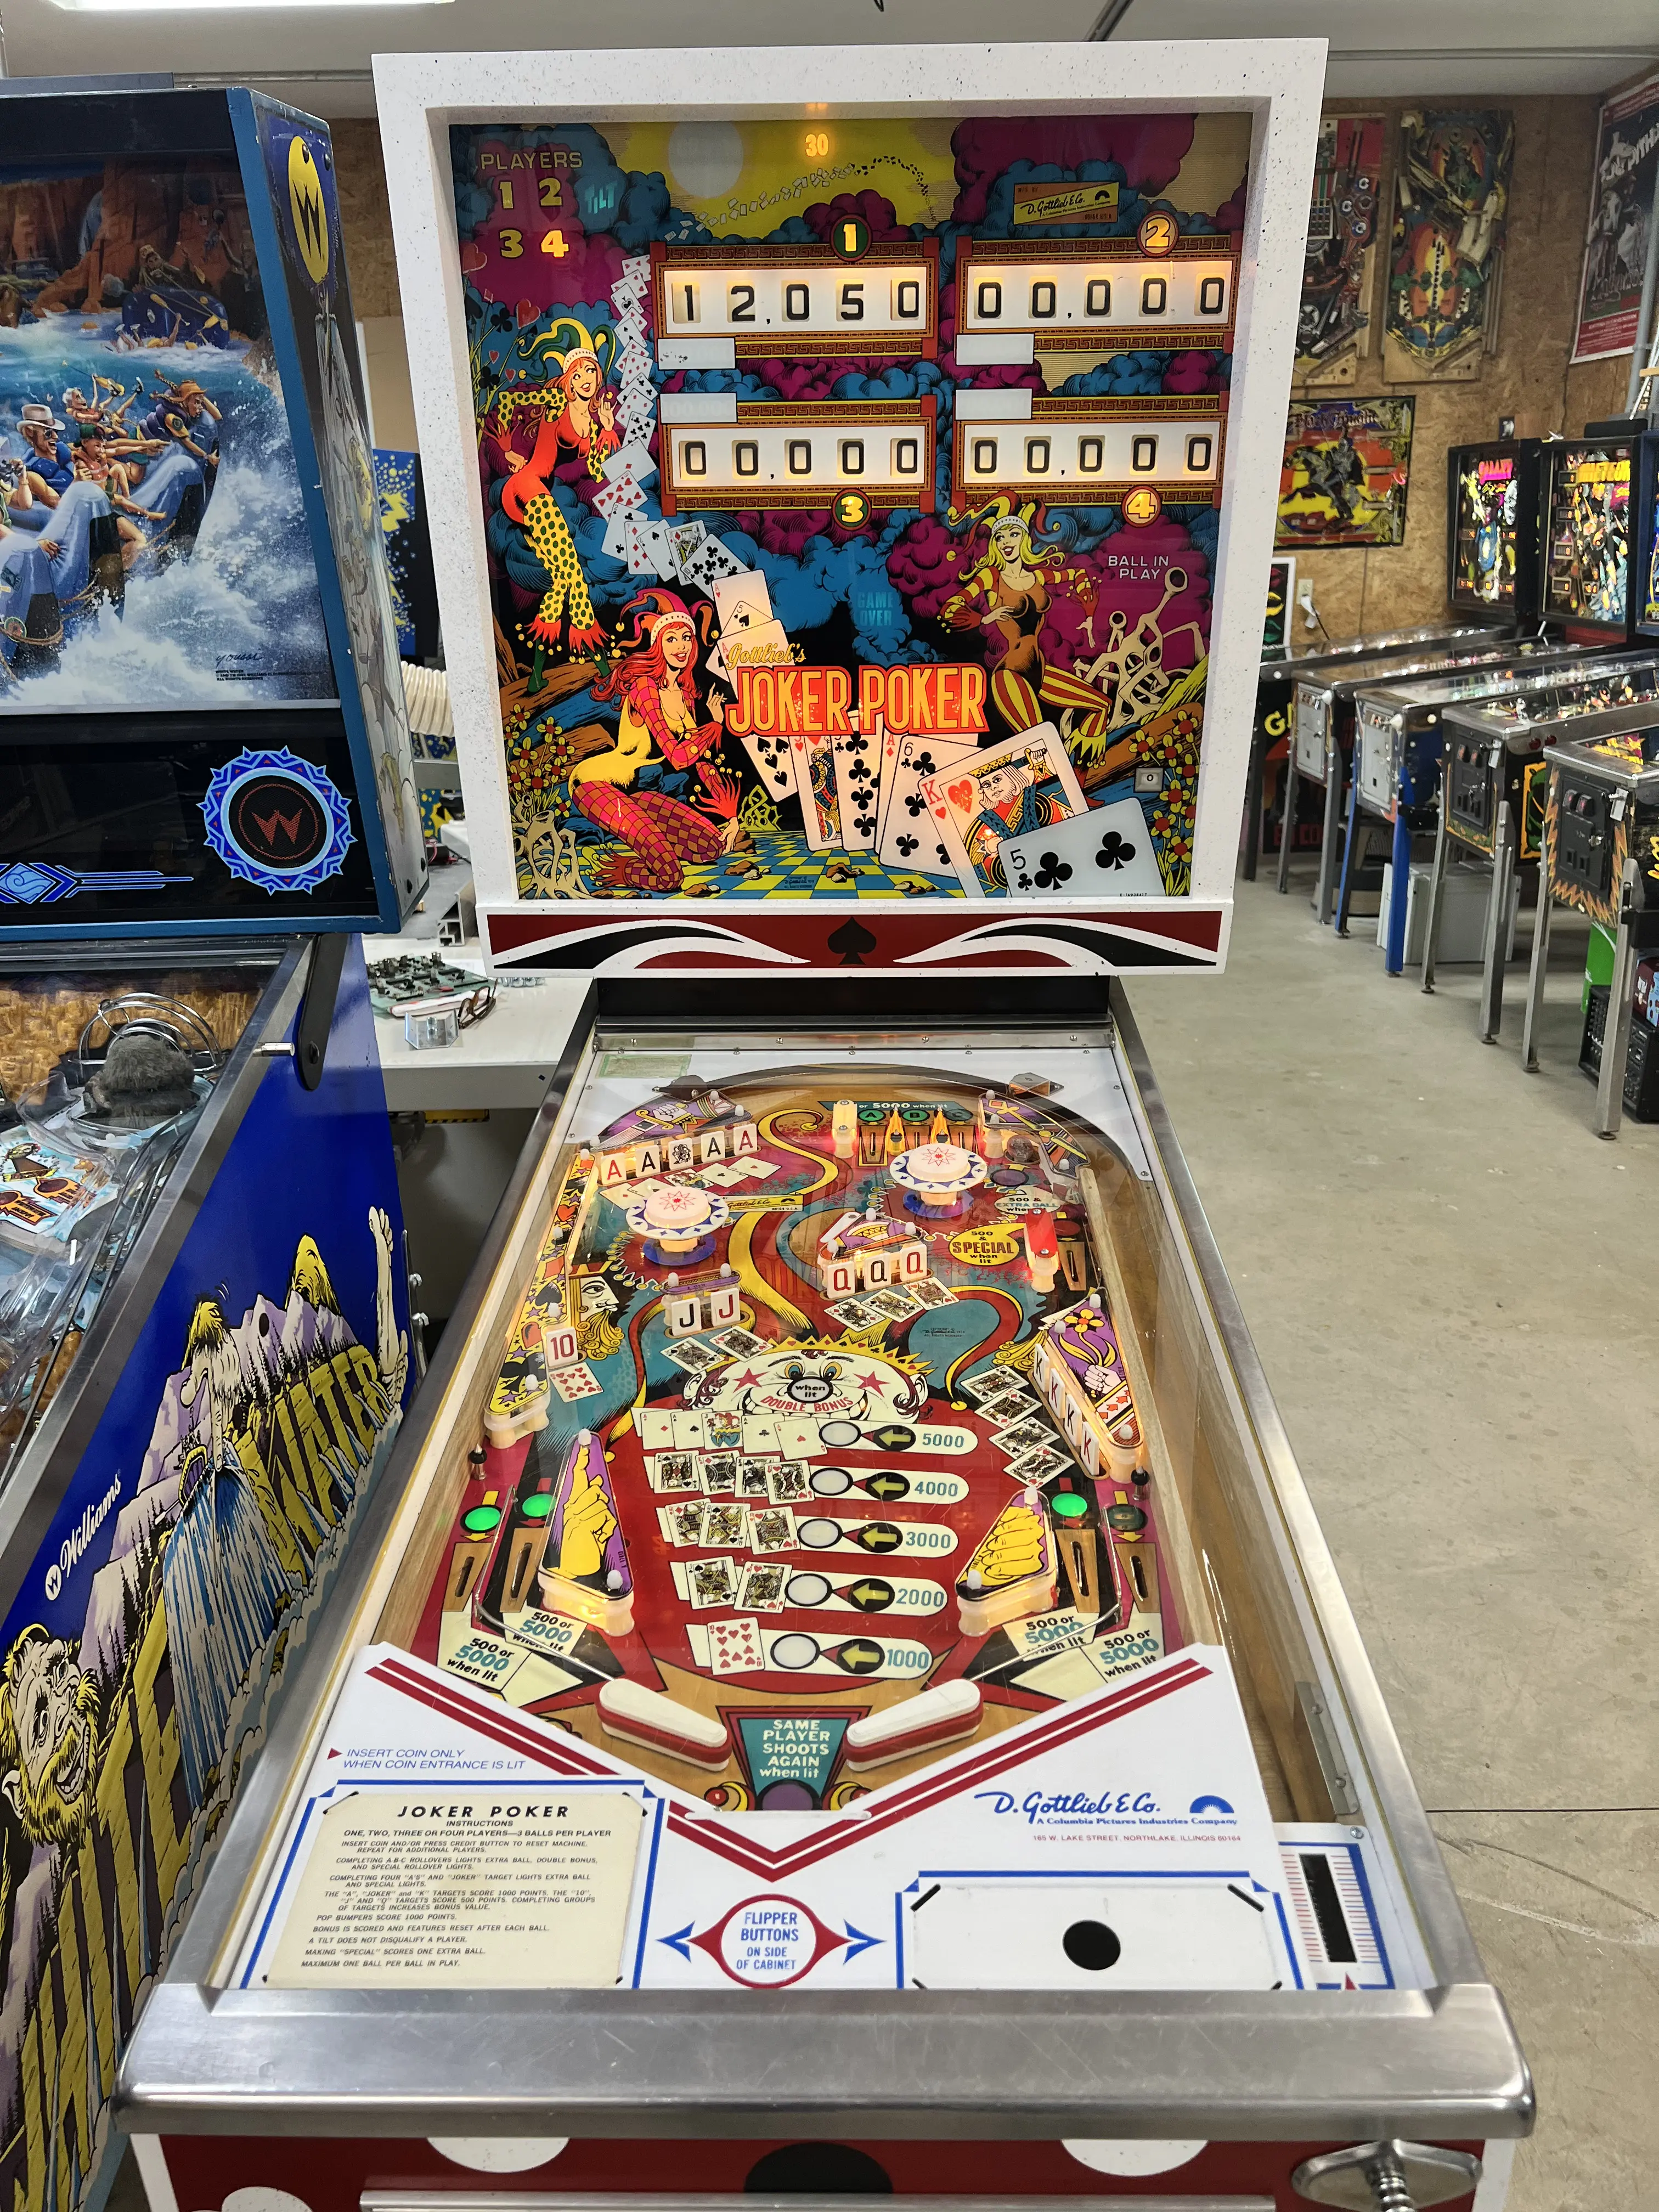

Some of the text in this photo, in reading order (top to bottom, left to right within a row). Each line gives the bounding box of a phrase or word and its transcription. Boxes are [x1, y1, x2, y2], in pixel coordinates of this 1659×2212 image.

[805, 133, 829, 157] 30
[481, 151, 583, 170] PLAYERS
[499, 177, 562, 210] 1 2
[1020, 203, 1036, 215] D.
[1037, 195, 1068, 217] Gottlieb
[499, 229, 569, 258] 3 4
[843, 223, 857, 252] 1
[1144, 218, 1174, 249] 2
[840, 496, 865, 522] 3
[1127, 492, 1155, 518] 4
[1108, 555, 1169, 567] BALL IN
[1119, 568, 1161, 580] PLAY
[857, 591, 893, 608] GAME
[860, 610, 892, 626] OVER
[725, 643, 806, 670] Gottlieb's
[727, 666, 987, 735] JOKER POKER
[904, 744, 913, 756] 6
[921, 779, 943, 805] K
[1010, 849, 1026, 870] 5
[607, 1130, 753, 1180] A A A A
[952, 1242, 1014, 1254] SPECIAL
[833, 1251, 923, 1291] Q Q Q
[679, 1295, 734, 1329] J J
[550, 1333, 573, 1359] 10
[1035, 1352, 1043, 1376] K
[760, 1396, 854, 1412] DOUBLE BONUS
[1051, 1383, 1059, 1408] K
[1068, 1409, 1076, 1436] K
[922, 1432, 964, 1448] 5000
[1084, 1436, 1091, 1464] K
[913, 1481, 958, 1497] 4000
[60, 1474, 121, 1578] Williams
[905, 1532, 951, 1548] 3000
[896, 1588, 945, 1607] 2000
[531, 1612, 575, 1629] 500 or
[1026, 1615, 1074, 1630] 500 or
[519, 1619, 572, 1643] 5000
[1025, 1621, 1086, 1644] 5000
[1104, 1629, 1150, 1649] 500 or
[470, 1638, 515, 1658] 500 or
[1068, 1635, 1086, 1648] lit
[1099, 1638, 1159, 1664] 5000
[455, 1645, 509, 1671] 5000
[887, 1648, 929, 1669] 1000
[1104, 1655, 1156, 1677] when lit
[447, 1658, 499, 1682] when lit
[772, 1719, 820, 1730] SAME
[763, 1730, 831, 1741] PLAYER
[347, 1749, 465, 1758] INSERT COIN ONLY
[763, 1743, 830, 1755] SHOOTS
[343, 1760, 526, 1769] WHEN COIN ENTRANCE IS LIT
[768, 1756, 820, 1767] AGAIN
[759, 1768, 819, 1778] when lit
[398, 1805, 568, 1818] JOKER POKER
[974, 1791, 1019, 1814] D.
[1023, 1791, 1112, 1824] Gottlieb
[1133, 1792, 1161, 1813] Co.
[1191, 1818, 1237, 1826] Company
[744, 1912, 798, 1925] FLIPPER
[741, 1928, 799, 1942] BUTTONS
[747, 1946, 787, 1957] ON SIDE
[736, 1959, 796, 1970] OF CABINET
